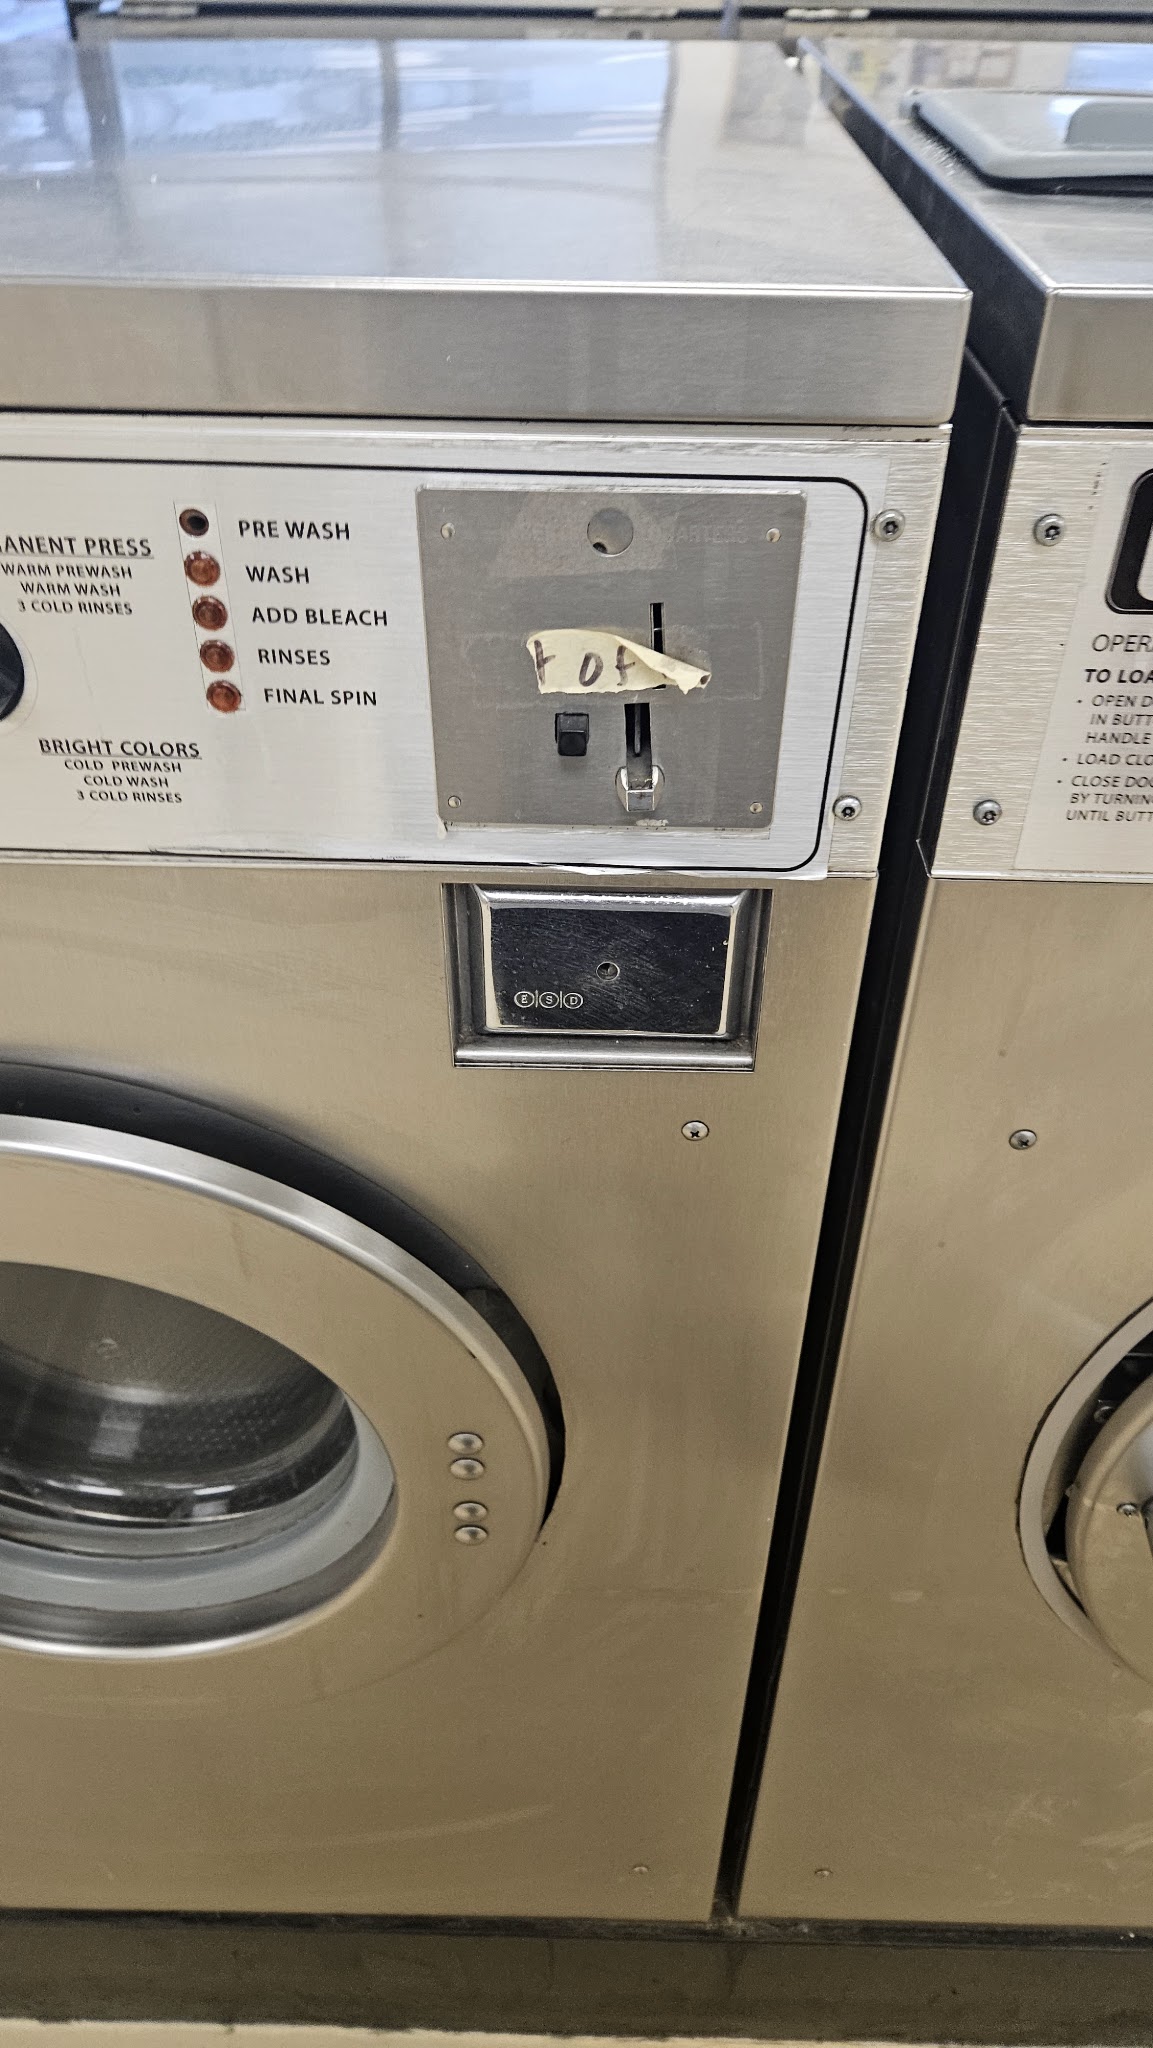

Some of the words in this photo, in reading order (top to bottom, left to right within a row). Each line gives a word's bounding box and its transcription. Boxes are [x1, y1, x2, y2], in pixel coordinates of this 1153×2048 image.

[238, 519, 280, 538] PRE
[285, 521, 350, 541] WASH
[0, 535, 77, 555] ANENT
[84, 537, 152, 557] PRESS
[0, 562, 51, 577] WARM
[56, 564, 133, 579] PREWASH
[245, 565, 310, 585] WASH
[20, 581, 70, 596] WARM
[74, 583, 121, 598] WASH
[18, 599, 26, 613] 3
[31, 599, 73, 614] COLD
[78, 601, 133, 616] RINSES
[252, 607, 298, 625] ADD
[305, 608, 388, 627] BLEACH
[1092, 634, 1153, 653] OPER
[257, 648, 331, 666] RINSES
[1084, 668, 1111, 684] TO
[1117, 669, 1153, 684] LOA
[263, 688, 325, 705] FINAL
[330, 690, 378, 706] SPIN
[1092, 694, 1138, 708] OPEN
[1090, 713, 1108, 726] IN
[1111, 713, 1153, 727] BUTT
[1085, 732, 1152, 745] HANDLE
[38, 738, 112, 756] BRIGHT
[120, 741, 201, 759] COLORS
[64, 759, 104, 771] COLD
[112, 760, 182, 773] PREWASH
[1077, 753, 1121, 766] LOAD
[1125, 754, 1153, 766] CLO
[84, 775, 123, 787] COLD
[126, 776, 169, 788] WASH
[1071, 775, 1121, 788] CLOSE
[77, 790, 85, 801] 3
[89, 790, 128, 802] COLD
[132, 792, 182, 804] RINSES
[1070, 793, 1090, 804] BY
[1066, 810, 1110, 822] UNTIL
